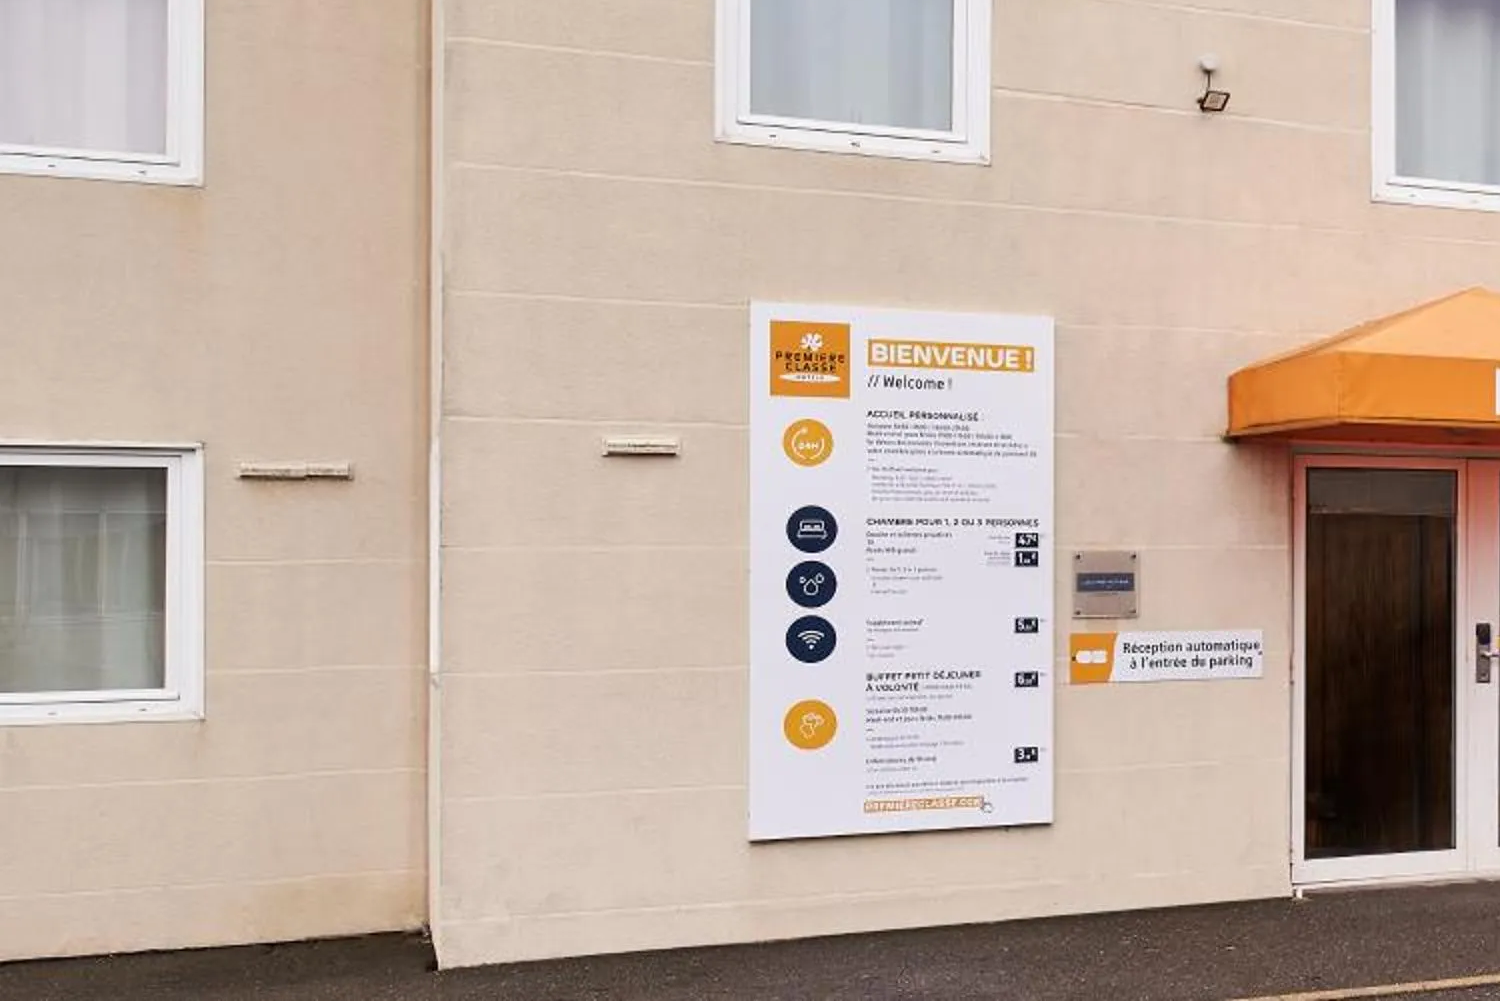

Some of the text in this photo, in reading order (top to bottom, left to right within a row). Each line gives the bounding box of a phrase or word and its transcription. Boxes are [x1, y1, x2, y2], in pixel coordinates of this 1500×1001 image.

[870, 342, 1021, 368] BIENVENUE
[785, 362, 837, 374] CLASSE
[883, 375, 946, 390] Welcome
[1122, 638, 1261, 656] Réception automatique
[1129, 653, 1254, 670] à l'entrée du parking
